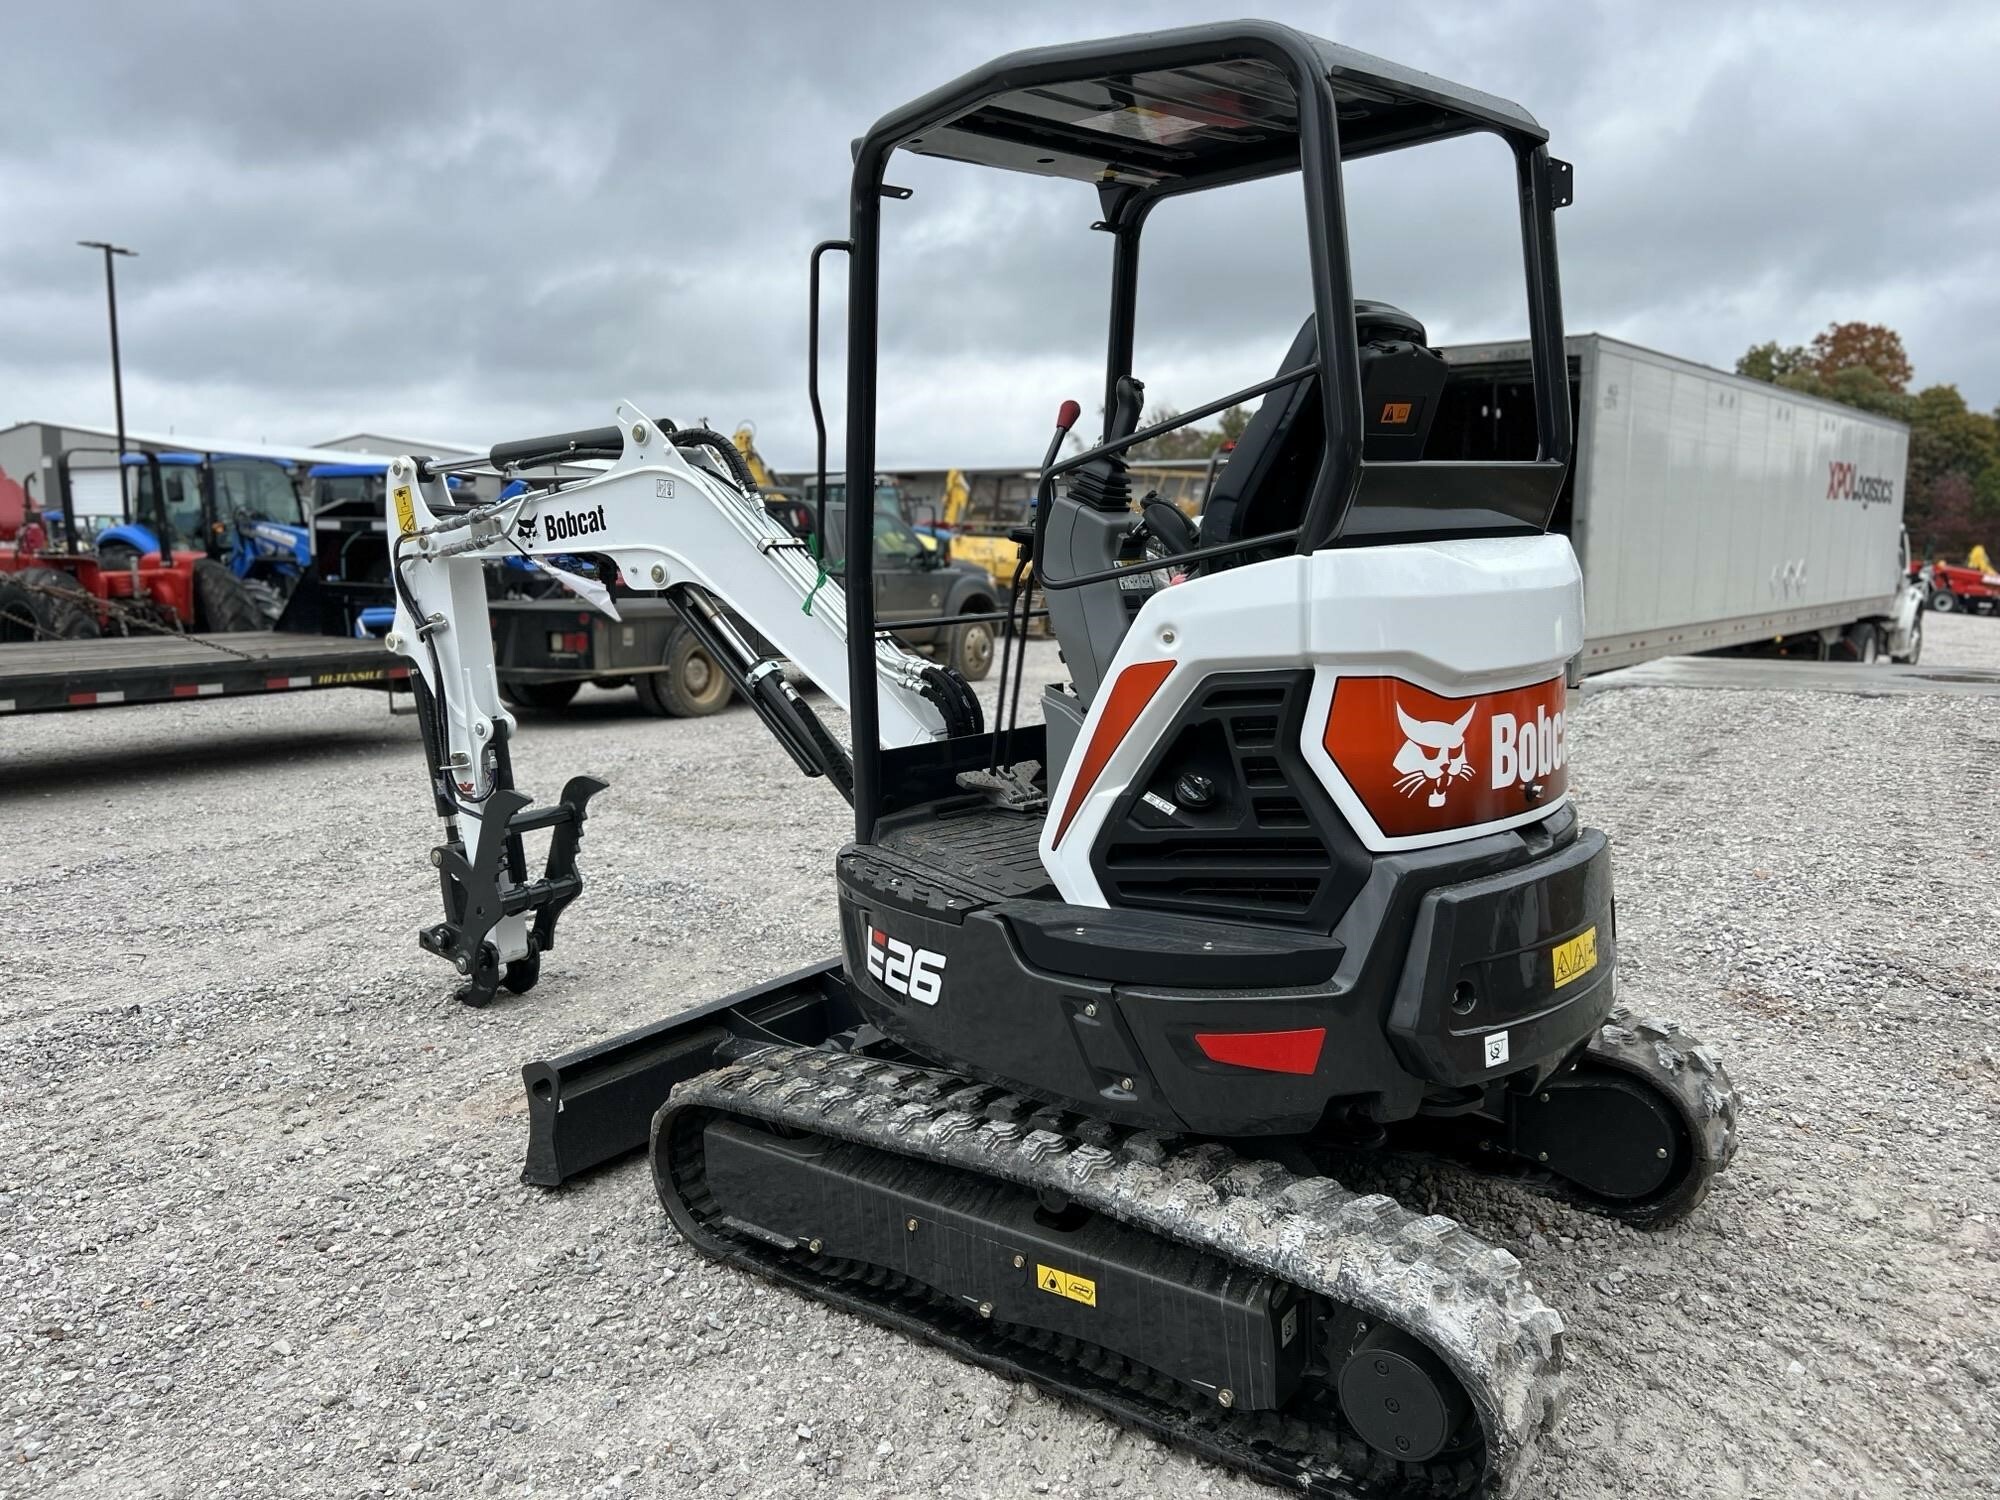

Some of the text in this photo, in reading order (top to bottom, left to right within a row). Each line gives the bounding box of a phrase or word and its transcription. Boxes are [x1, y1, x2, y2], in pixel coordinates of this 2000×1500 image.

[544, 504, 607, 542] Bobcat
[1491, 704, 1568, 790] Bobc
[867, 924, 947, 1006] E26
